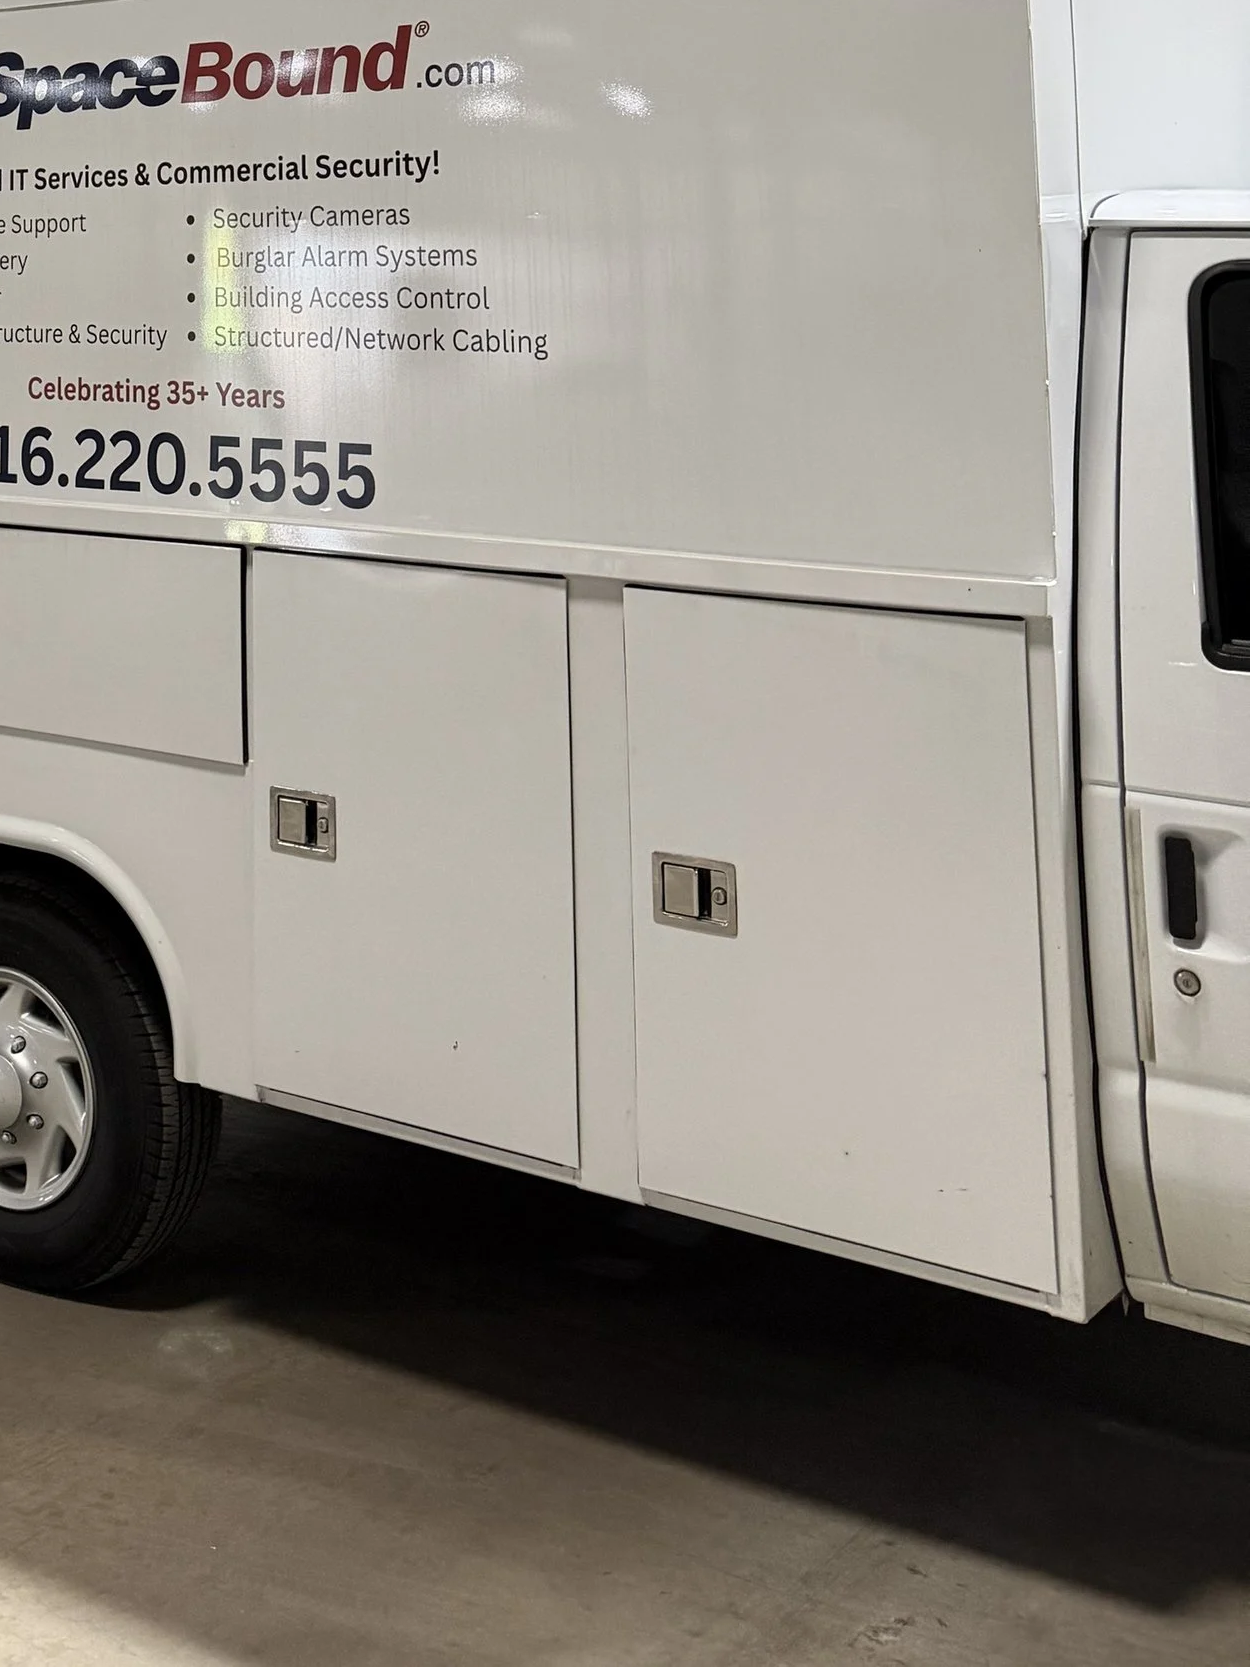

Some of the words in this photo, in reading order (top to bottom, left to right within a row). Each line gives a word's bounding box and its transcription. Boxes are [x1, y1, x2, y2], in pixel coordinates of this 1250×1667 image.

[9, 169, 28, 192] IT
[35, 165, 128, 190] Services
[134, 163, 150, 186] &
[156, 155, 308, 185] Commercial
[315, 150, 440, 183] Security!
[11, 214, 87, 238] Support
[213, 207, 302, 233] Security
[310, 205, 410, 227] Cameras
[217, 245, 295, 273] Burglar
[302, 246, 367, 267] Alarm
[376, 245, 477, 272] Systems
[215, 286, 303, 314] Building
[310, 288, 389, 309] Access
[397, 286, 490, 310] Control
[69, 324, 81, 344] &
[86, 324, 167, 350] Security
[215, 326, 445, 351] Structured/Network
[453, 329, 549, 360] Cabling
[28, 377, 160, 410] Celebrating
[167, 380, 208, 405] 35+
[216, 382, 285, 409] Years
